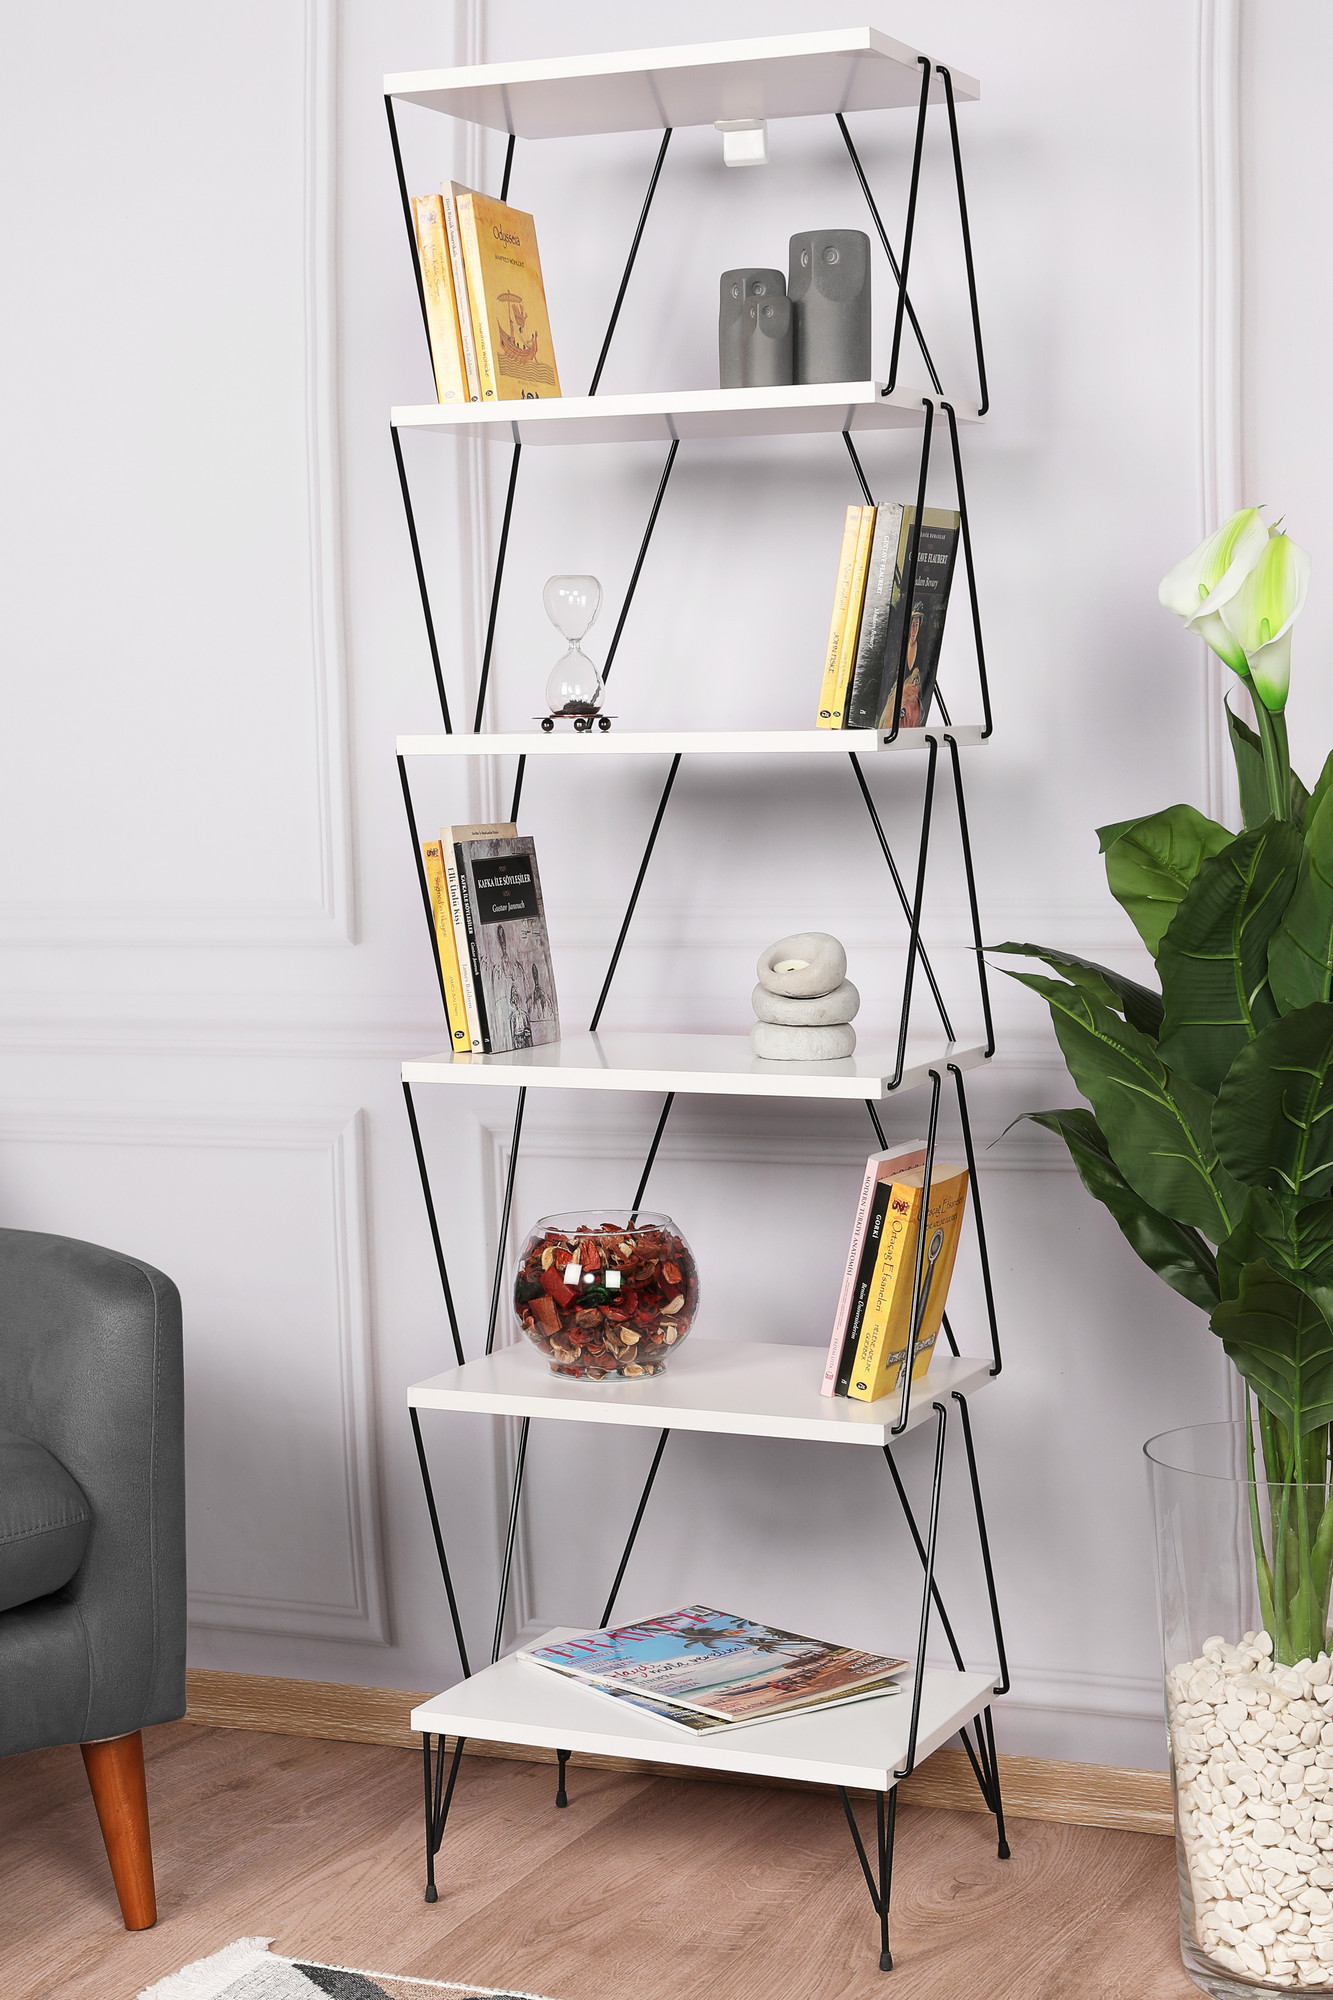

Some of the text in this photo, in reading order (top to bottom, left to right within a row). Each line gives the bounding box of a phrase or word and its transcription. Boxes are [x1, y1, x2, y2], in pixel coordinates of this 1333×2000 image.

[877, 535, 890, 595] GUSTAVE FLAUBERT
[831, 632, 840, 654] JOHN
[447, 867, 457, 882] Elli
[477, 877, 495, 889] KAFKA
[449, 884, 461, 907] Ünlü
[861, 1175, 871, 1207] MODERN
[875, 1262, 894, 1312] Efsaneleri
[530, 1611, 724, 1659] TRAVEL
